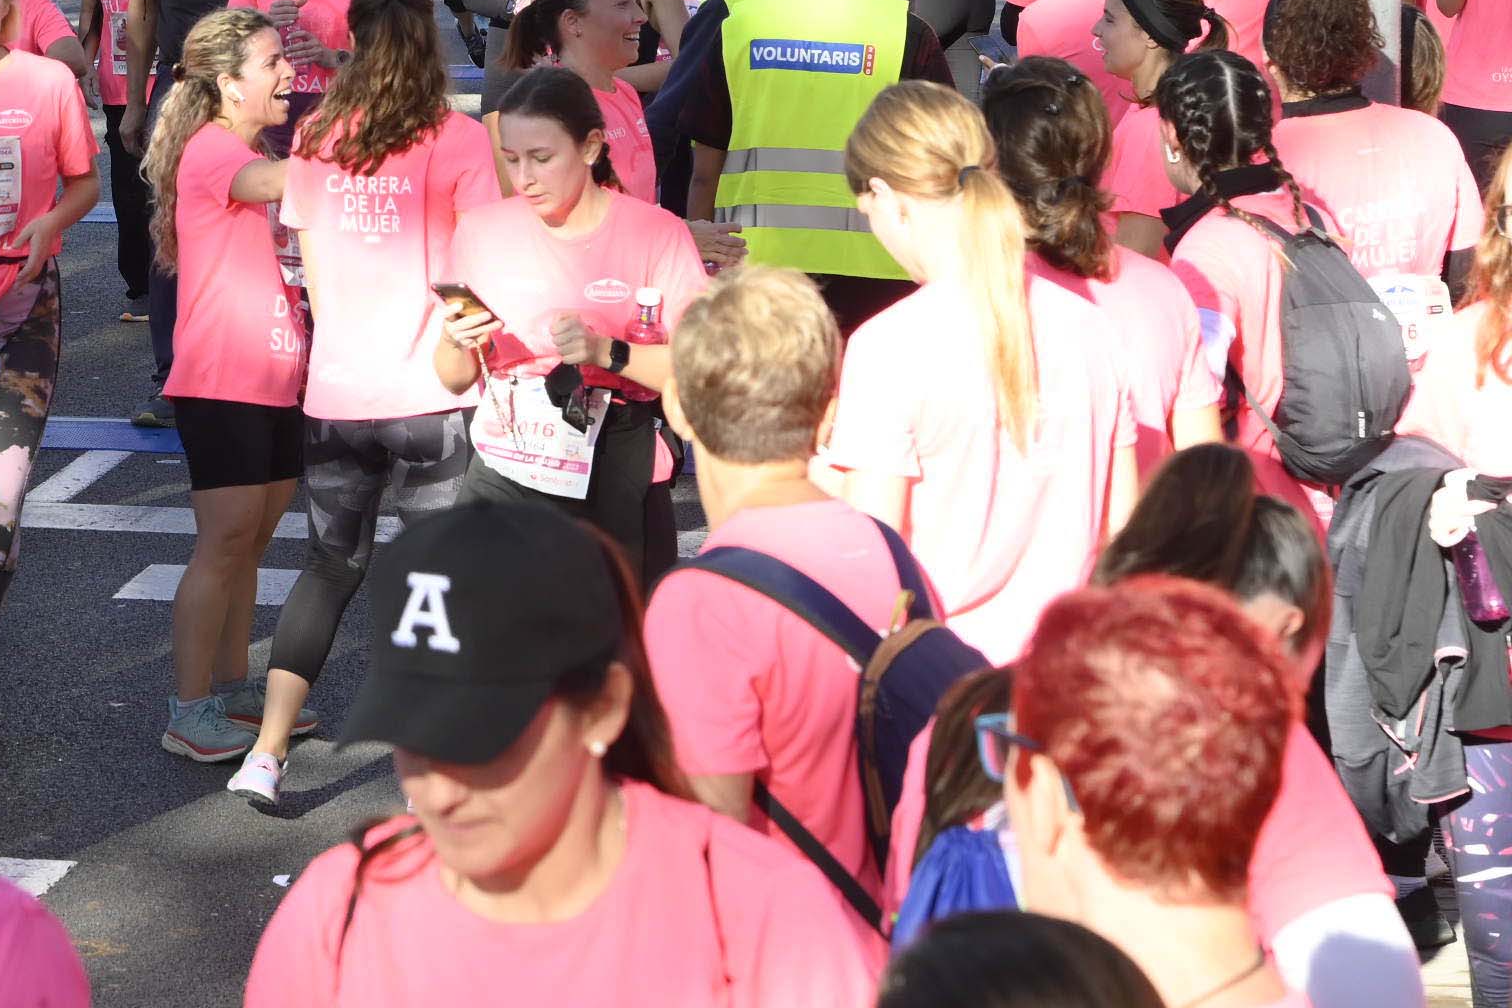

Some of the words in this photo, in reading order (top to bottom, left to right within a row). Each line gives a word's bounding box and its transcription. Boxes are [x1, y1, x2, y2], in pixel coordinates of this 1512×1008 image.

[752, 46, 860, 67] VOLUNTARIS
[326, 174, 412, 194] CARRERA
[343, 194, 368, 213] DE
[375, 196, 397, 213] LA
[341, 214, 401, 233] MUJER
[391, 572, 460, 652] A
